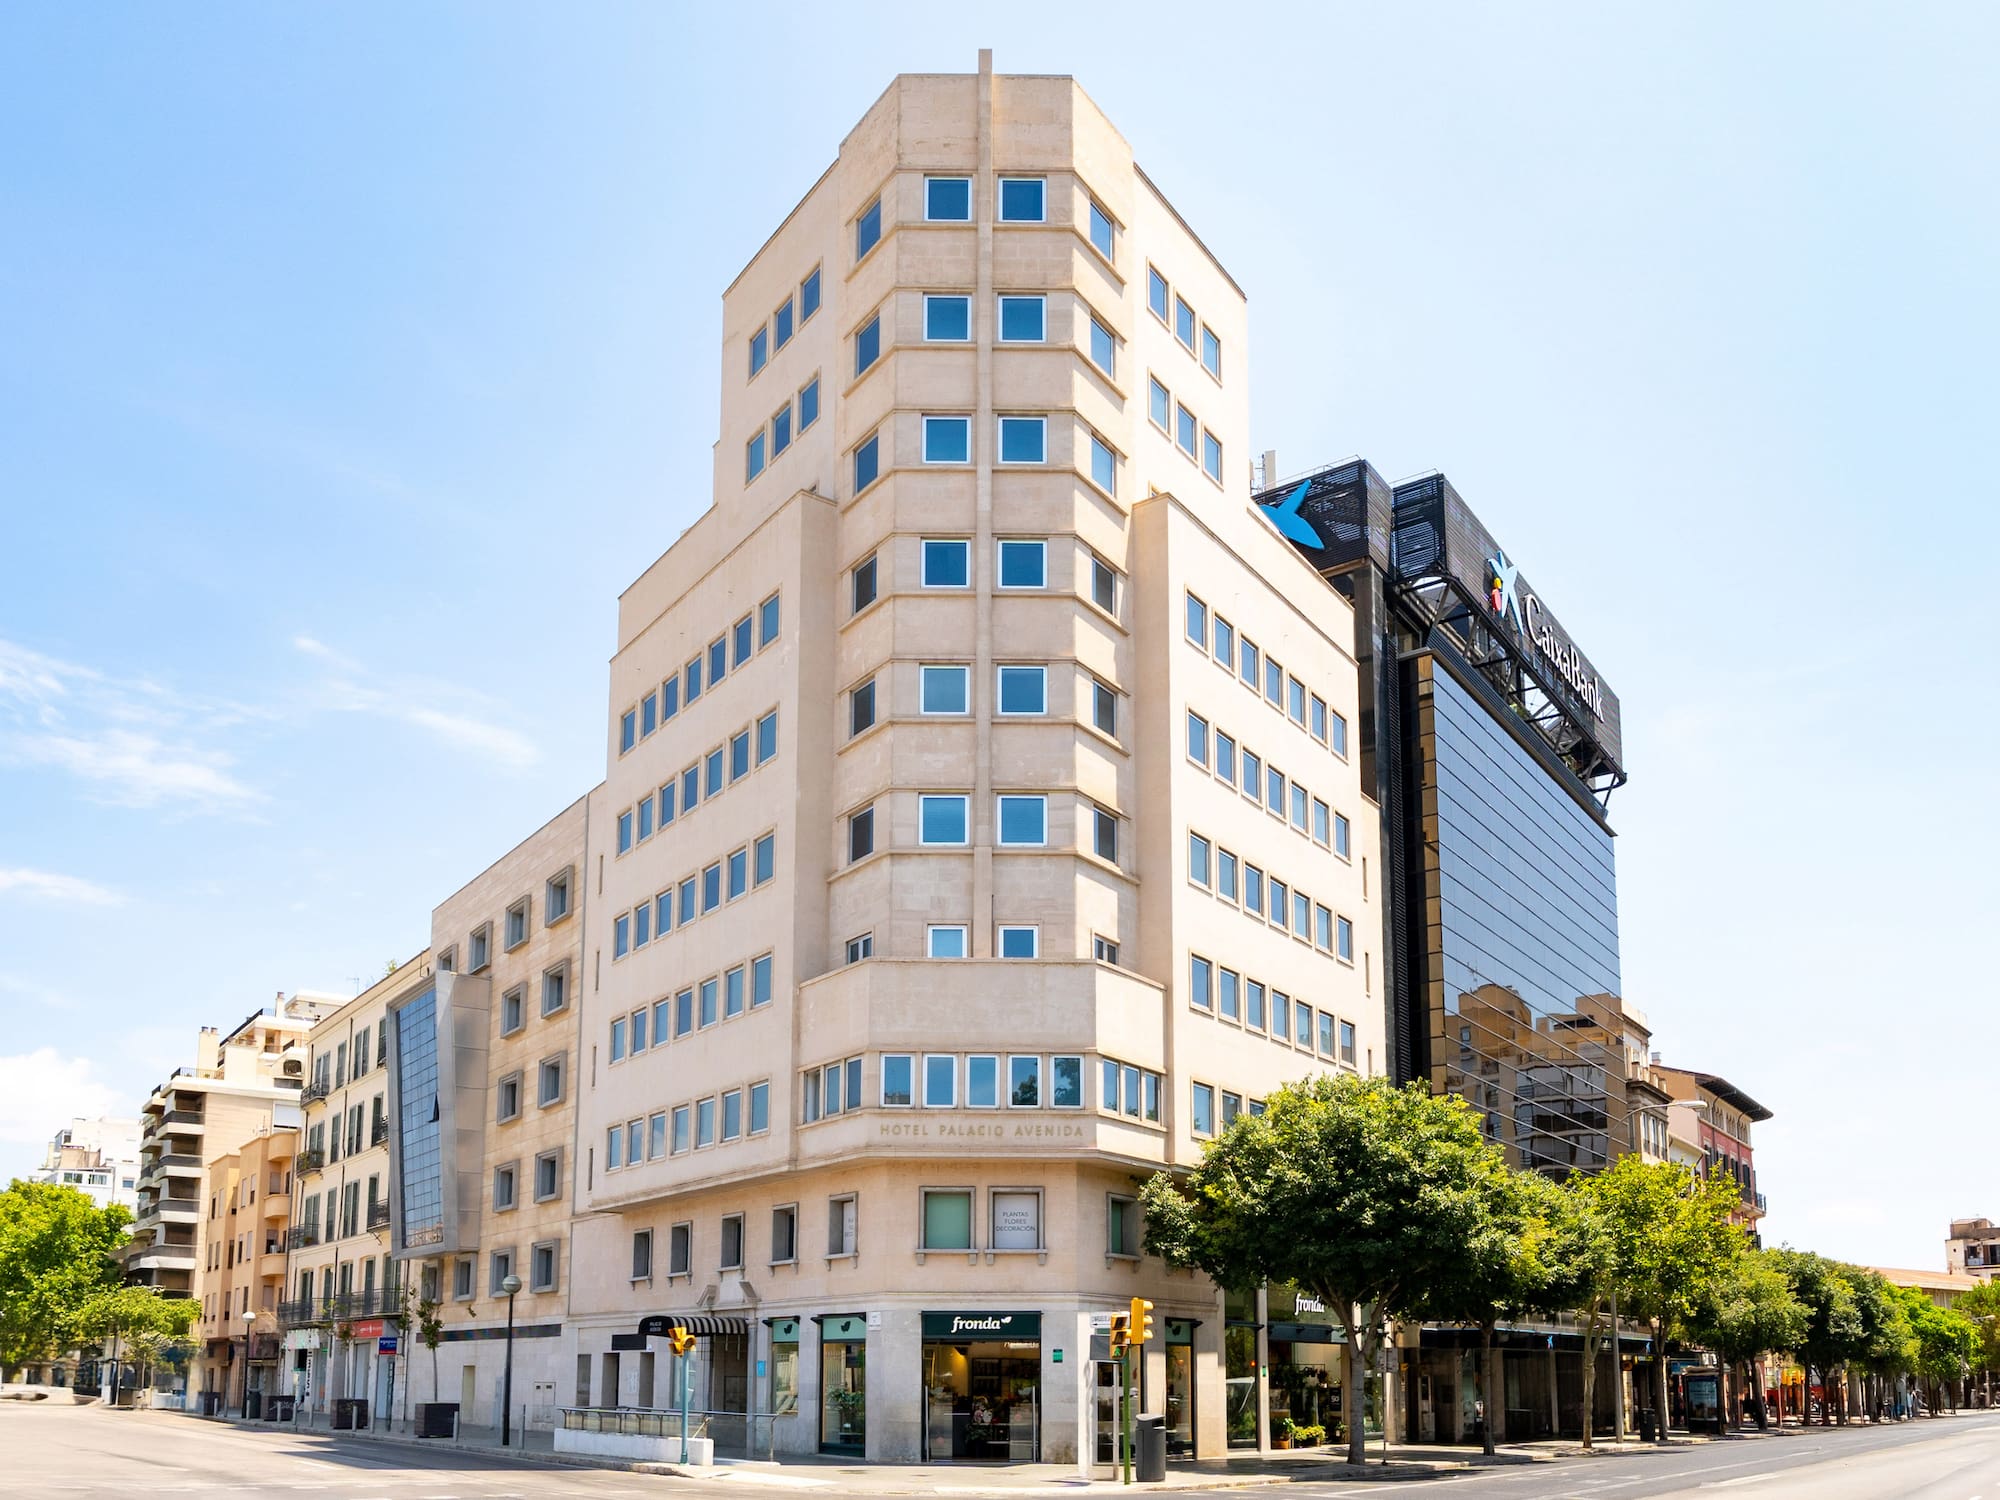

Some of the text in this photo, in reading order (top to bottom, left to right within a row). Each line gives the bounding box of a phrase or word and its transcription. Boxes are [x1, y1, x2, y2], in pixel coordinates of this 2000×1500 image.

[1525, 592, 1605, 724] CaixaBank
[880, 1124, 1083, 1137] HOTEL PALACIO AVENIDA
[950, 1316, 1001, 1333] fronda
